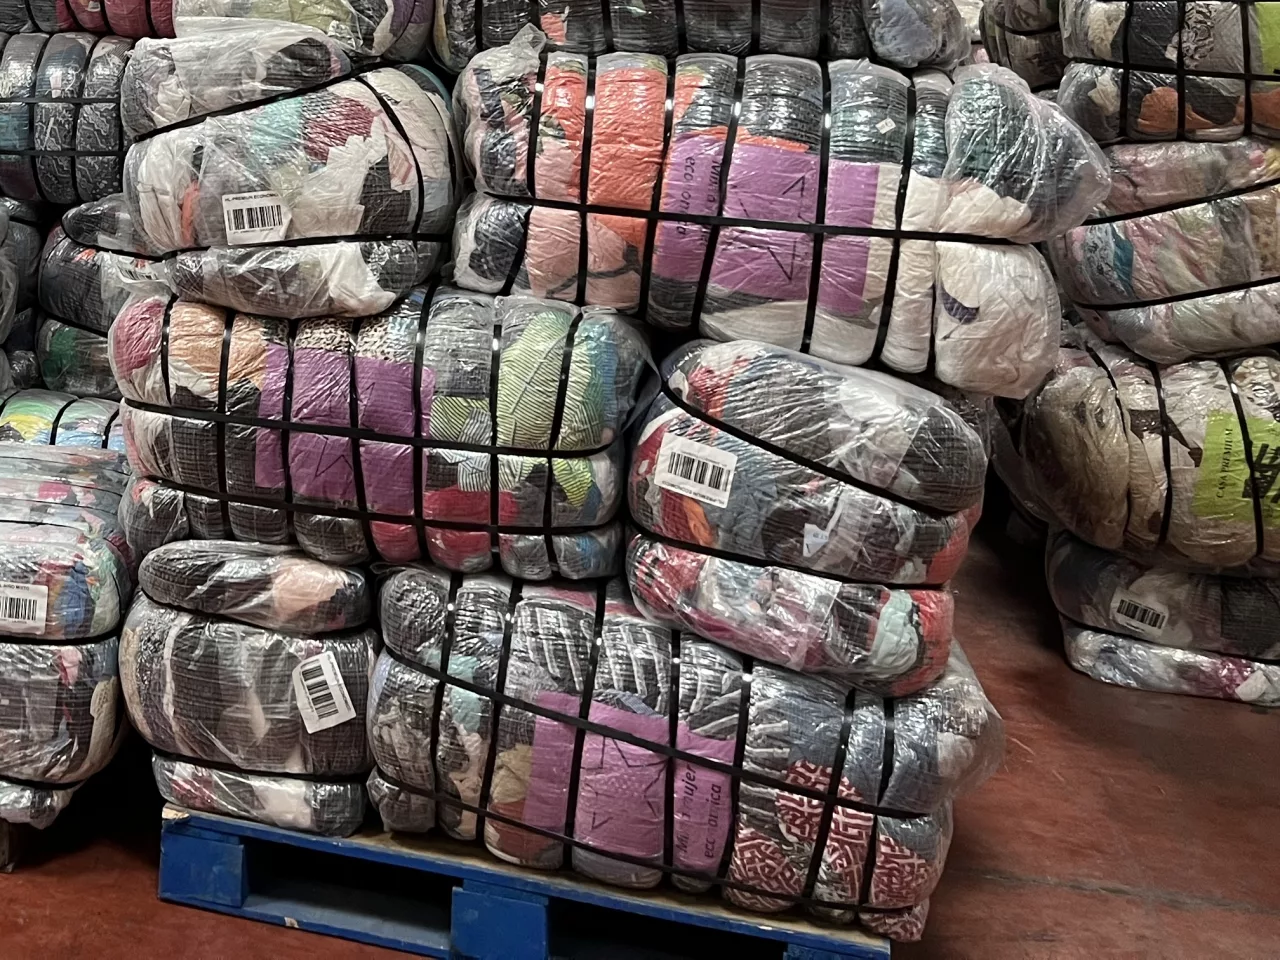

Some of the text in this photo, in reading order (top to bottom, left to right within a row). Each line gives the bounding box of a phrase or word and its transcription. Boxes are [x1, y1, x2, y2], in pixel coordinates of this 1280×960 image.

[676, 156, 696, 236] ecoomca
[1216, 428, 1233, 498] CASA PREMIUM
[704, 783, 722, 859] ecoomica
